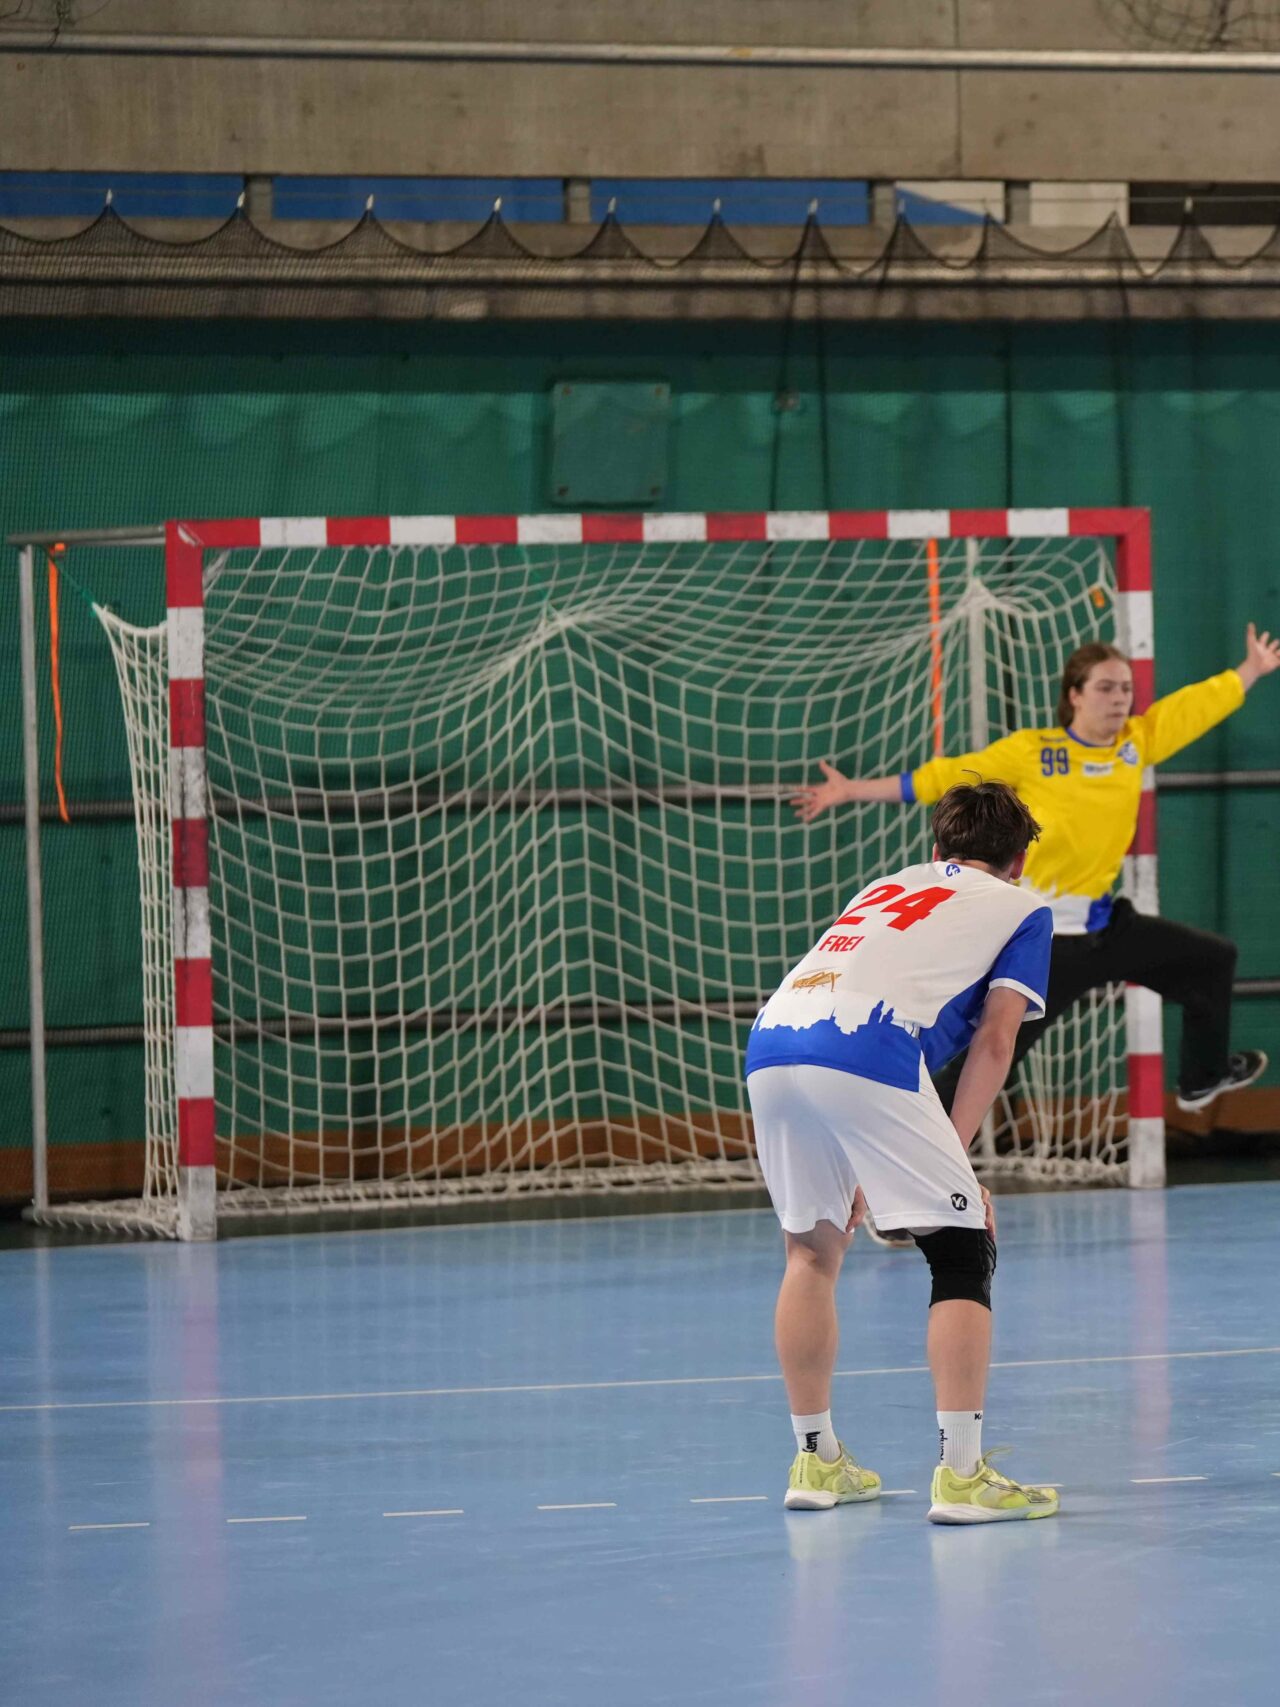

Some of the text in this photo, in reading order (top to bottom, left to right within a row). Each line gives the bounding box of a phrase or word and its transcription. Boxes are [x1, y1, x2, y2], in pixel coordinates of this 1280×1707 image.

[1040, 746, 1069, 777] 99
[832, 884, 957, 931] 24
[818, 935, 865, 952] FREI
